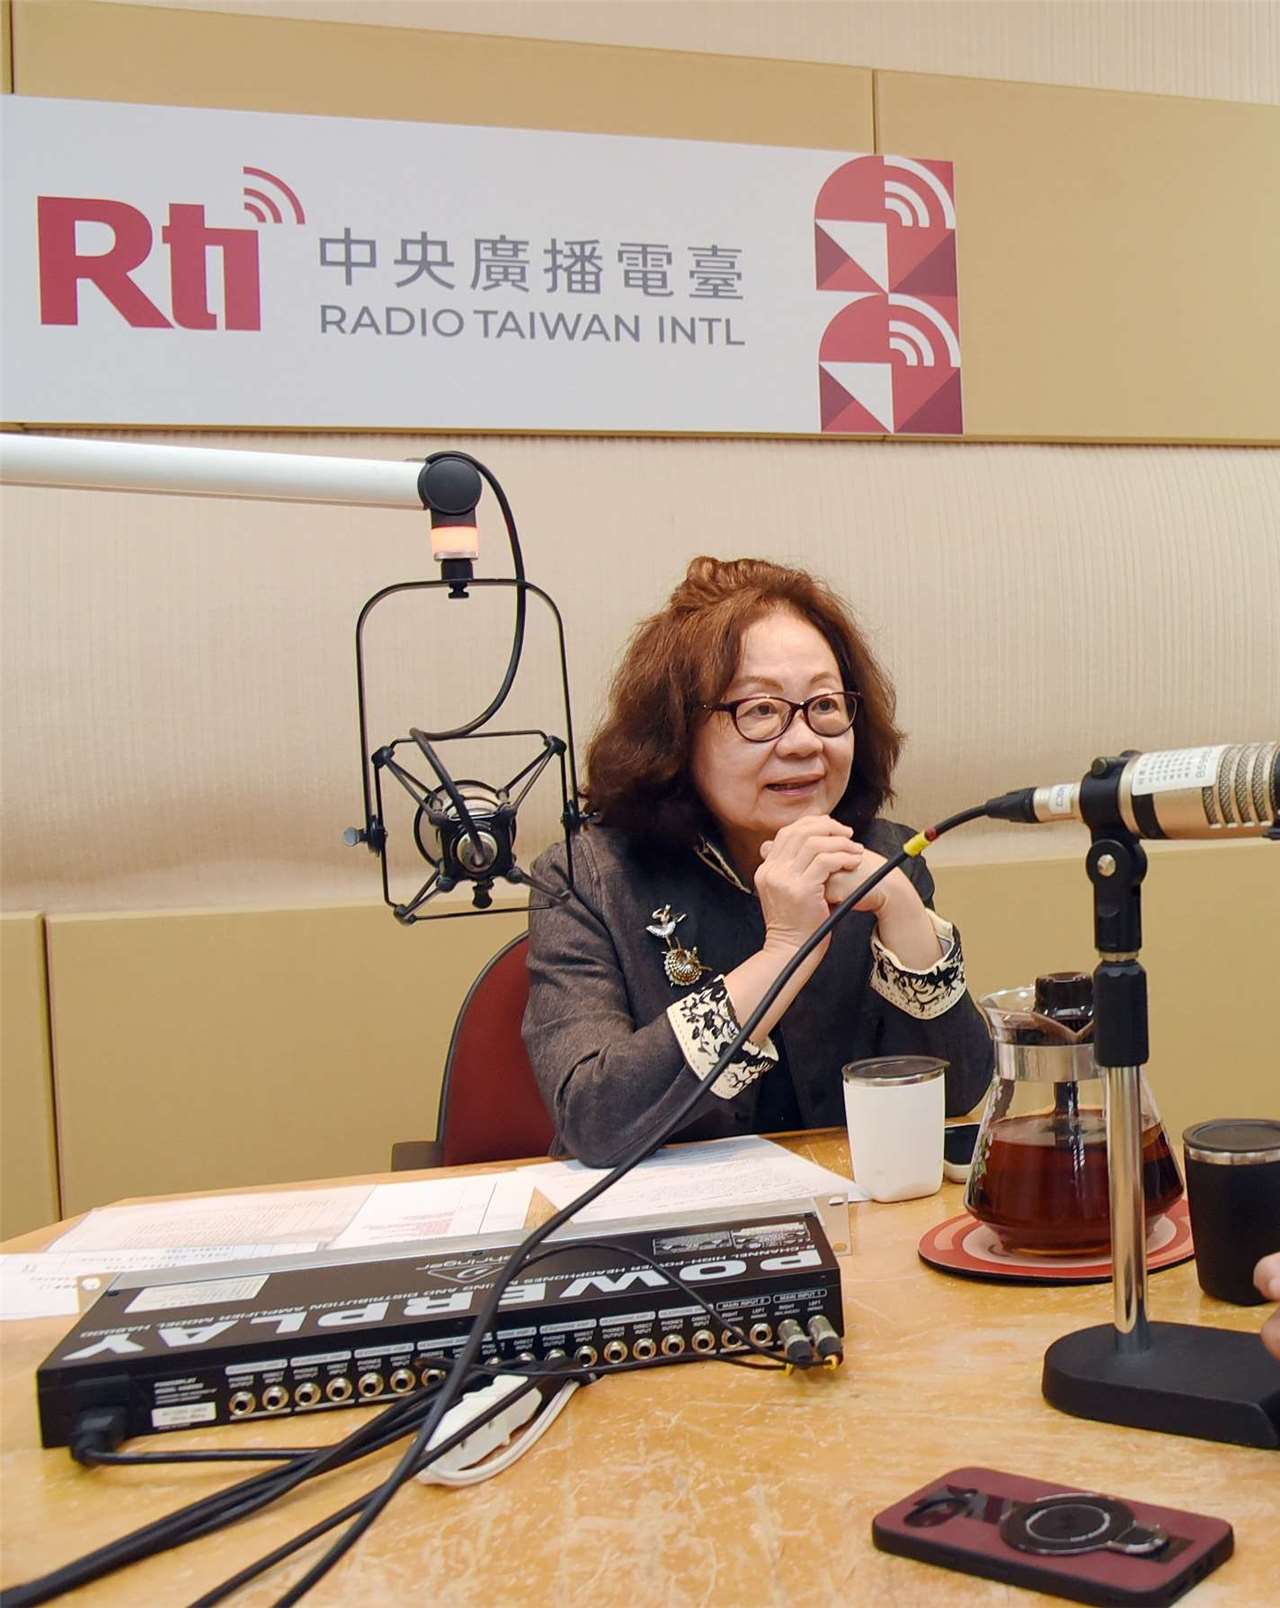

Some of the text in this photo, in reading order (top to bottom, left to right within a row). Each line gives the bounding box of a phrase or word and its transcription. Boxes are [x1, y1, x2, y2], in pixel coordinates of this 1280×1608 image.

[37, 195, 261, 332] Rti
[319, 227, 744, 300] 中央廣播電臺
[320, 304, 746, 346] RADIO TAIWAN INTL
[524, 1266, 627, 1285] HEADPHONES
[424, 1286, 457, 1297] AND
[63, 1250, 823, 1361] POWERPLAY
[309, 1292, 419, 1311] DISTRIBUTION
[157, 1316, 214, 1328] MODEL
[219, 1305, 305, 1321] AMPLIFIER
